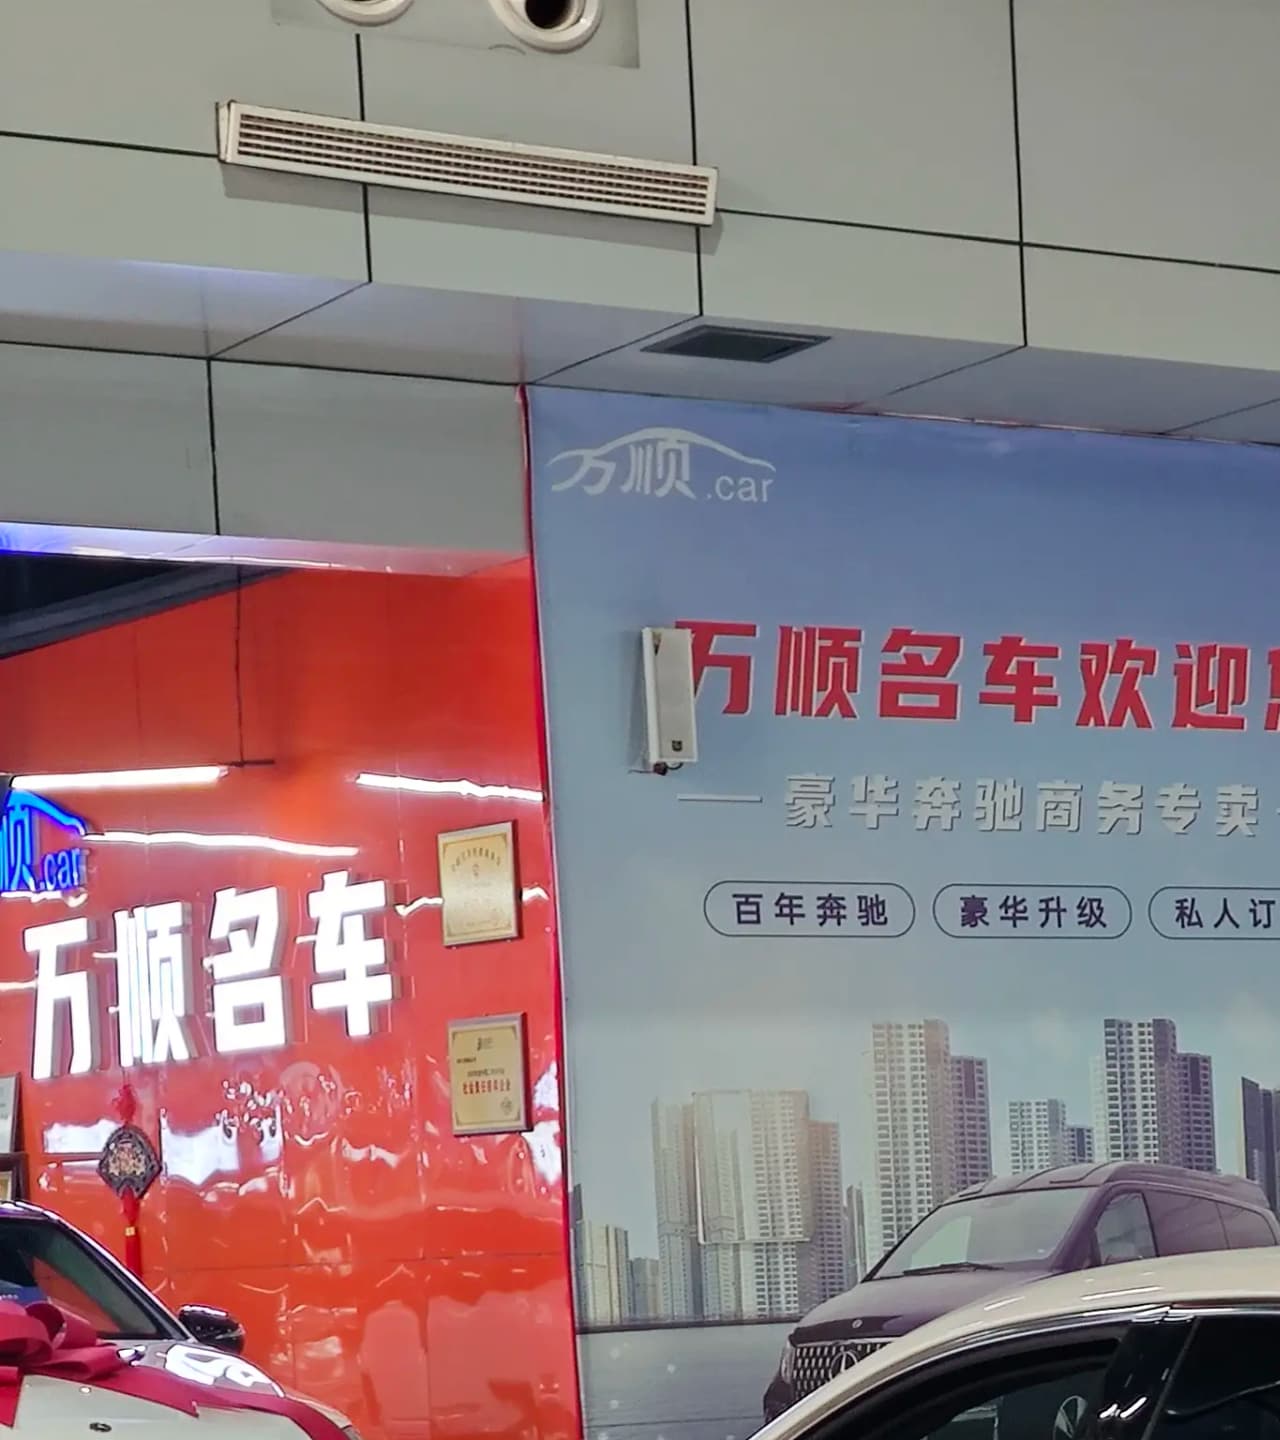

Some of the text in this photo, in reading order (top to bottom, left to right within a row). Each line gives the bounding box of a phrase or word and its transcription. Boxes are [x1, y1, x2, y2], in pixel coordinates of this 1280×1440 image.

[783, 773, 1261, 836] 豪华奔驰商务专卖
[732, 891, 889, 929] 百年奔驰
[958, 894, 1109, 931] 豪华升级
[23, 870, 398, 1081] 万顺名车
